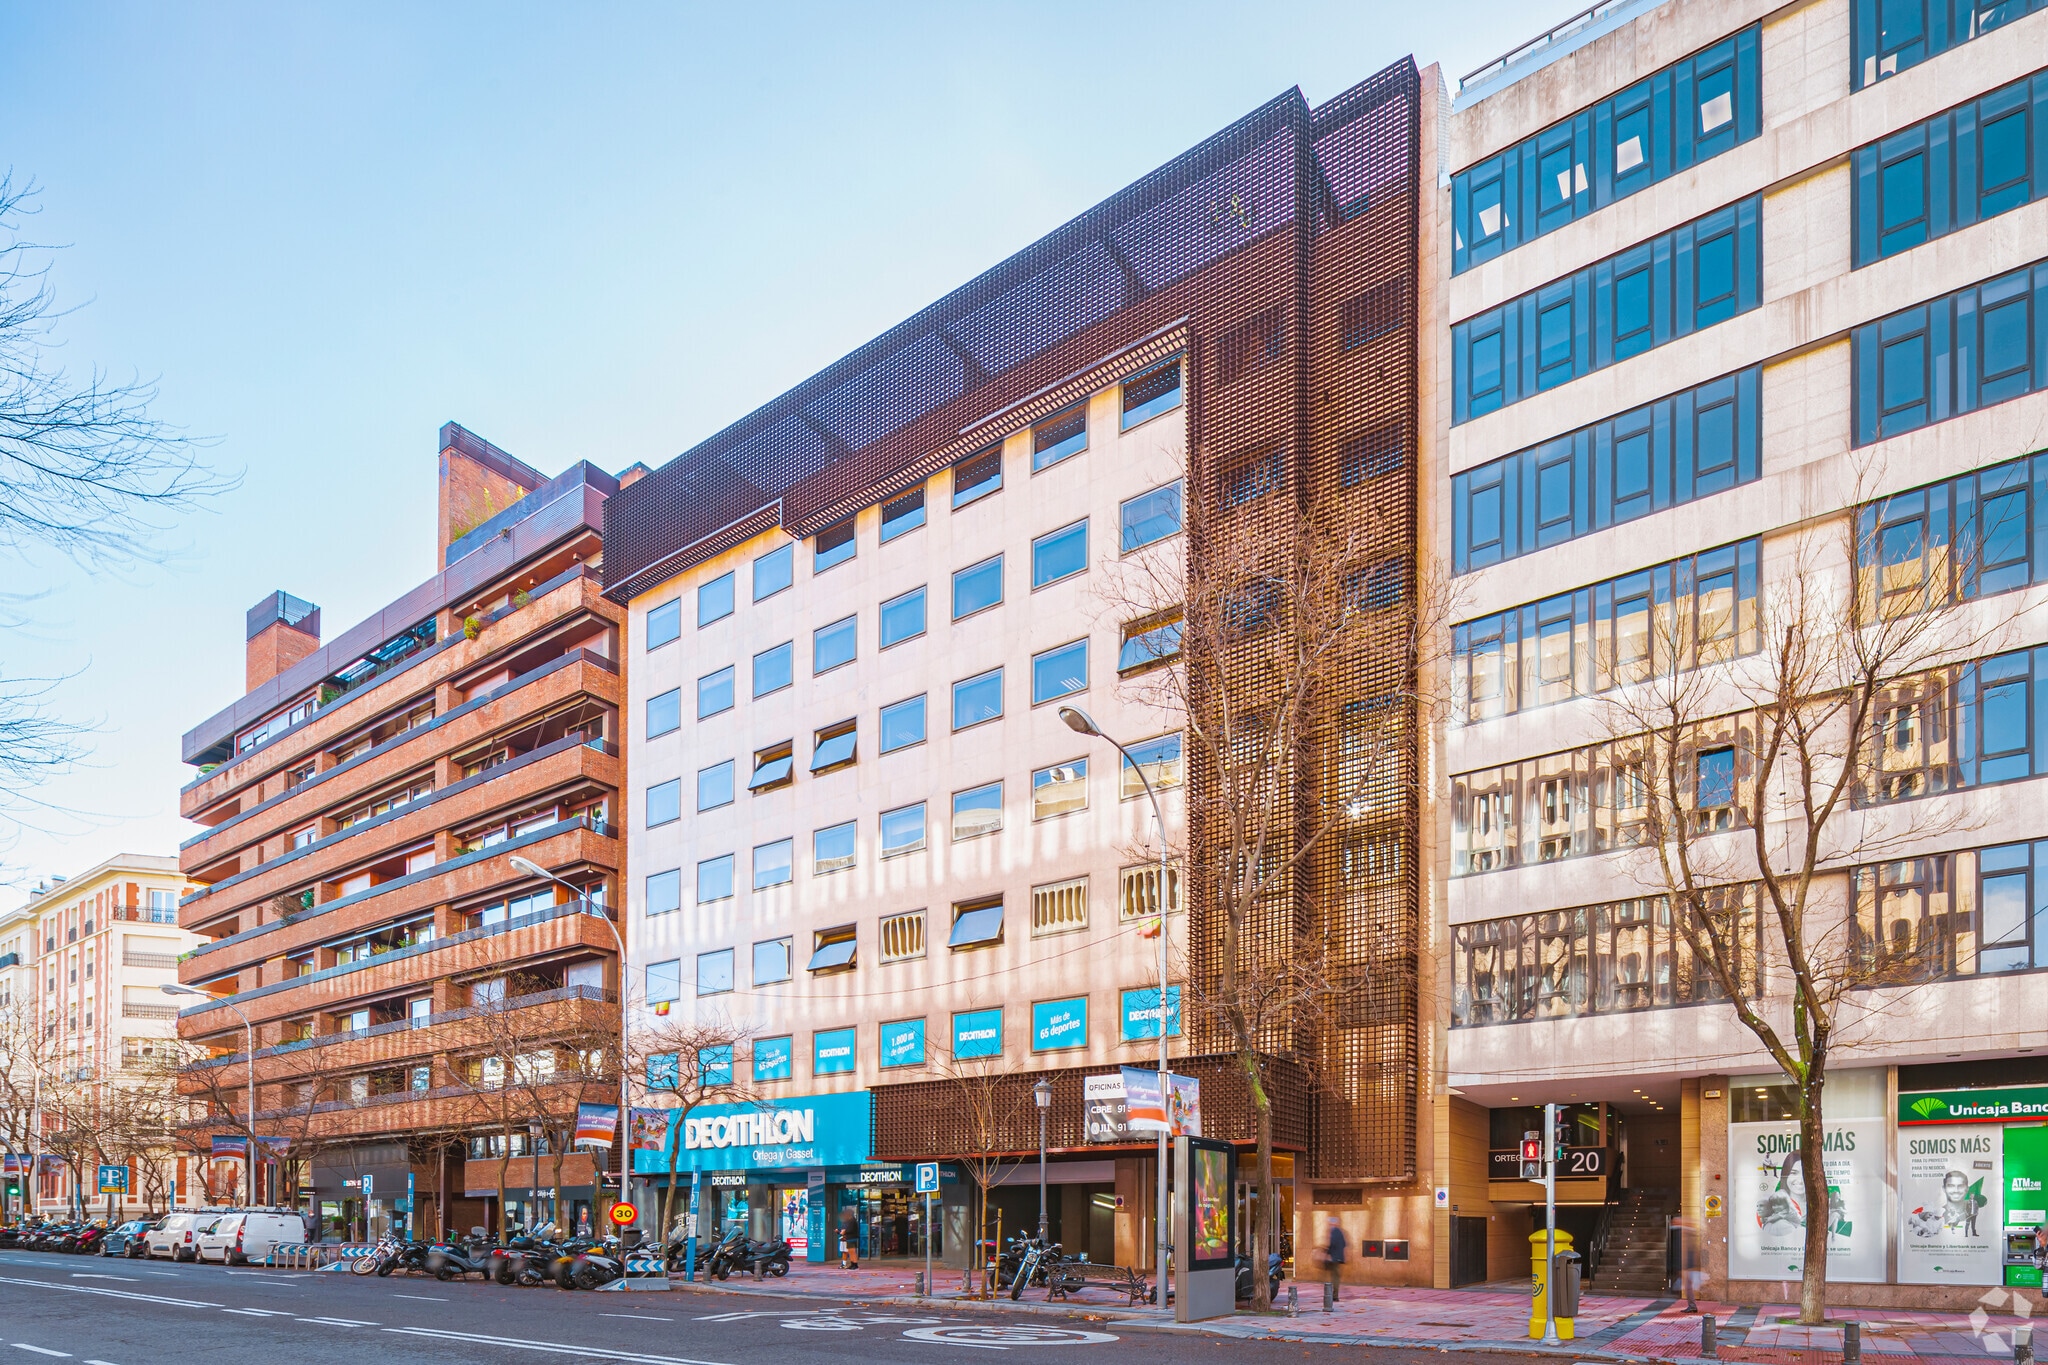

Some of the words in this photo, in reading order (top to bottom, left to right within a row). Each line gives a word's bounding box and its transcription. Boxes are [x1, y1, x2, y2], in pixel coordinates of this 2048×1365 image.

[1050, 1015, 1061, 1025] Más
[1062, 1011, 1070, 1021] de
[1129, 1007, 1174, 1022] DECATHLN
[959, 1028, 996, 1041] DECATHLON
[1040, 1028, 1049, 1040] 65
[1050, 1019, 1080, 1036] deportes
[891, 1034, 908, 1047] 1.800
[819, 1046, 850, 1058] DECATHLON
[891, 1049, 896, 1057] de
[897, 1043, 915, 1056] deporte
[1089, 1082, 1121, 1092] OFICINAS
[1091, 1105, 1112, 1114] CBRE
[1950, 1102, 2008, 1117] Unicaja
[685, 1109, 814, 1150] DECATHLON
[1118, 1123, 1127, 1132] 91
[1757, 1133, 1802, 1153] SOMO
[1822, 1128, 1855, 1152] MÁS
[1910, 1139, 1956, 1155] SOMOS
[1960, 1135, 1991, 1153] MÁS
[753, 1150, 777, 1162] Ortega
[779, 1152, 784, 1160] y
[786, 1148, 813, 1159] Gasset
[1494, 1154, 1520, 1163] ORTEG
[1571, 1151, 1600, 1172] 20
[711, 1175, 746, 1186] DECATHLON
[860, 1171, 902, 1182] DECATHLON
[921, 1166, 934, 1189] P
[2012, 1177, 2030, 1187] ATM
[363, 1177, 370, 1192] P
